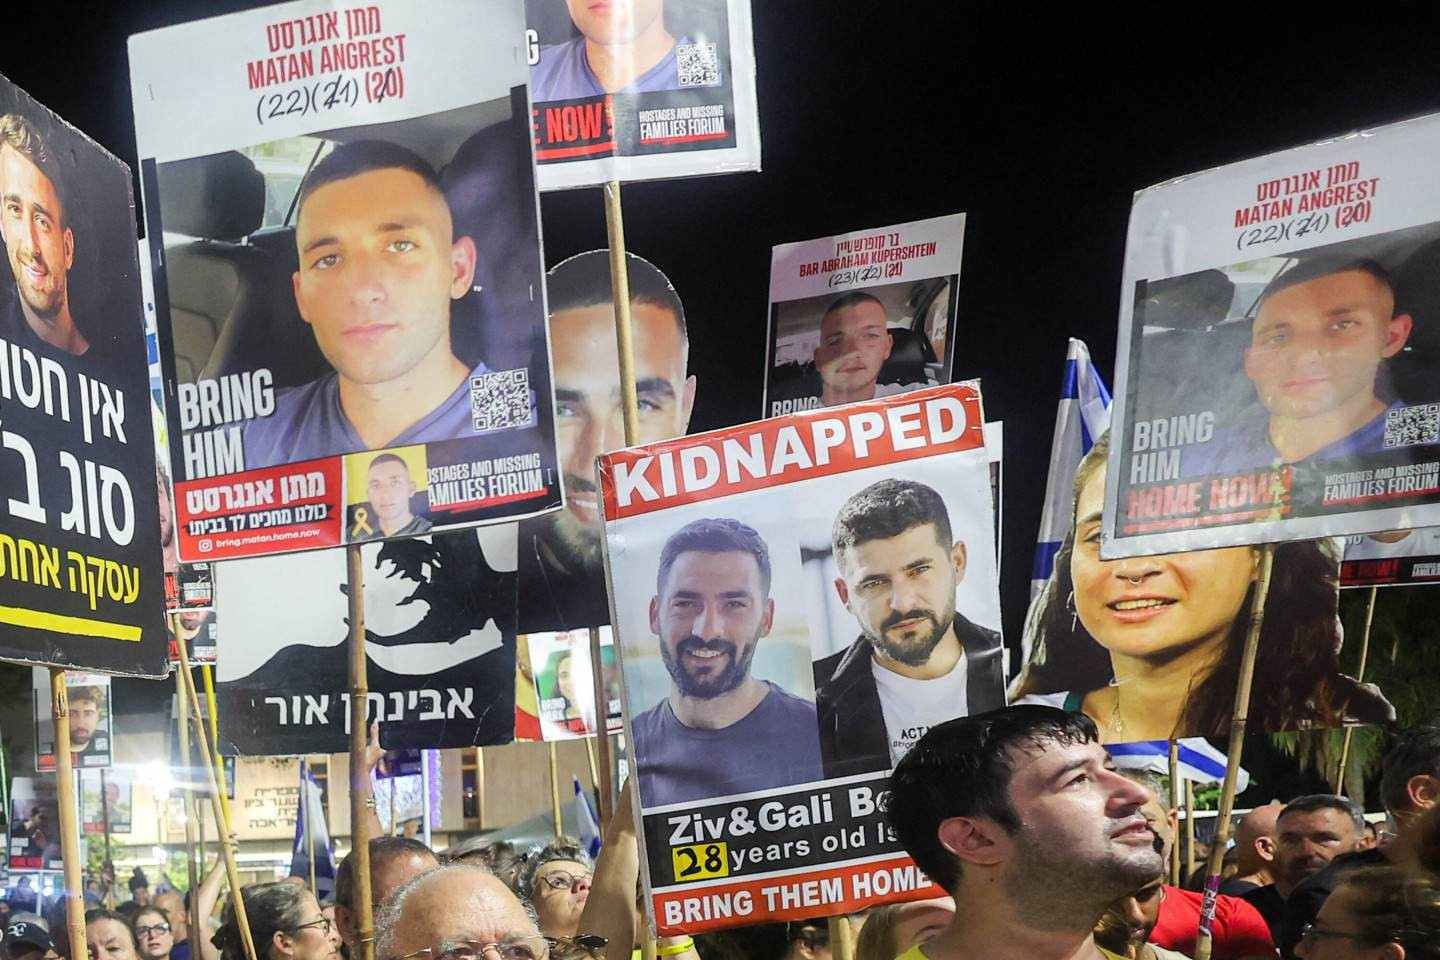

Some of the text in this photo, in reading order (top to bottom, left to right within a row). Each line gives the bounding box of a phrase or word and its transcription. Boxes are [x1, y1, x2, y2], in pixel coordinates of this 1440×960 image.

[266, 6, 381, 53] מתן אנגרסט
[247, 34, 407, 90] MATAN ANGREST
[546, 94, 614, 143] NOW!
[639, 104, 724, 123] HOSTAGES AND MISSING
[640, 116, 725, 140] FAMILIES FORUM
[1234, 178, 1380, 228] MATAN ANGREST
[1256, 160, 1360, 202] מתן אנגרסט
[799, 242, 937, 277] BAR ABRAHAM KUPERSHTEIN
[888, 233, 900, 246] בר
[77, 373, 128, 444] אין
[178, 368, 276, 430] BRING
[771, 396, 818, 417] BRING
[183, 424, 246, 480] HIM
[613, 395, 967, 507] KIDNAPPED
[1133, 411, 1214, 452] BRING
[427, 467, 544, 507] AMILIES FORUM
[471, 453, 541, 477] AND MISSING
[1130, 449, 1181, 485] HIM
[1323, 469, 1439, 502] FAMILIES FORUM
[1325, 461, 1440, 485] HOSTAGES AND MISSING
[59, 450, 136, 546] סוג
[186, 471, 327, 515] מתן אנגרסט
[1127, 482, 1202, 519] HOME
[229, 504, 327, 532] כולנו מחכים לך
[66, 551, 141, 611] עסקה
[264, 686, 475, 735] אבינתן אור
[668, 801, 832, 847] Ziv&Gali
[676, 825, 865, 878] 28 years old
[664, 866, 933, 927] BRING THEM HOME
